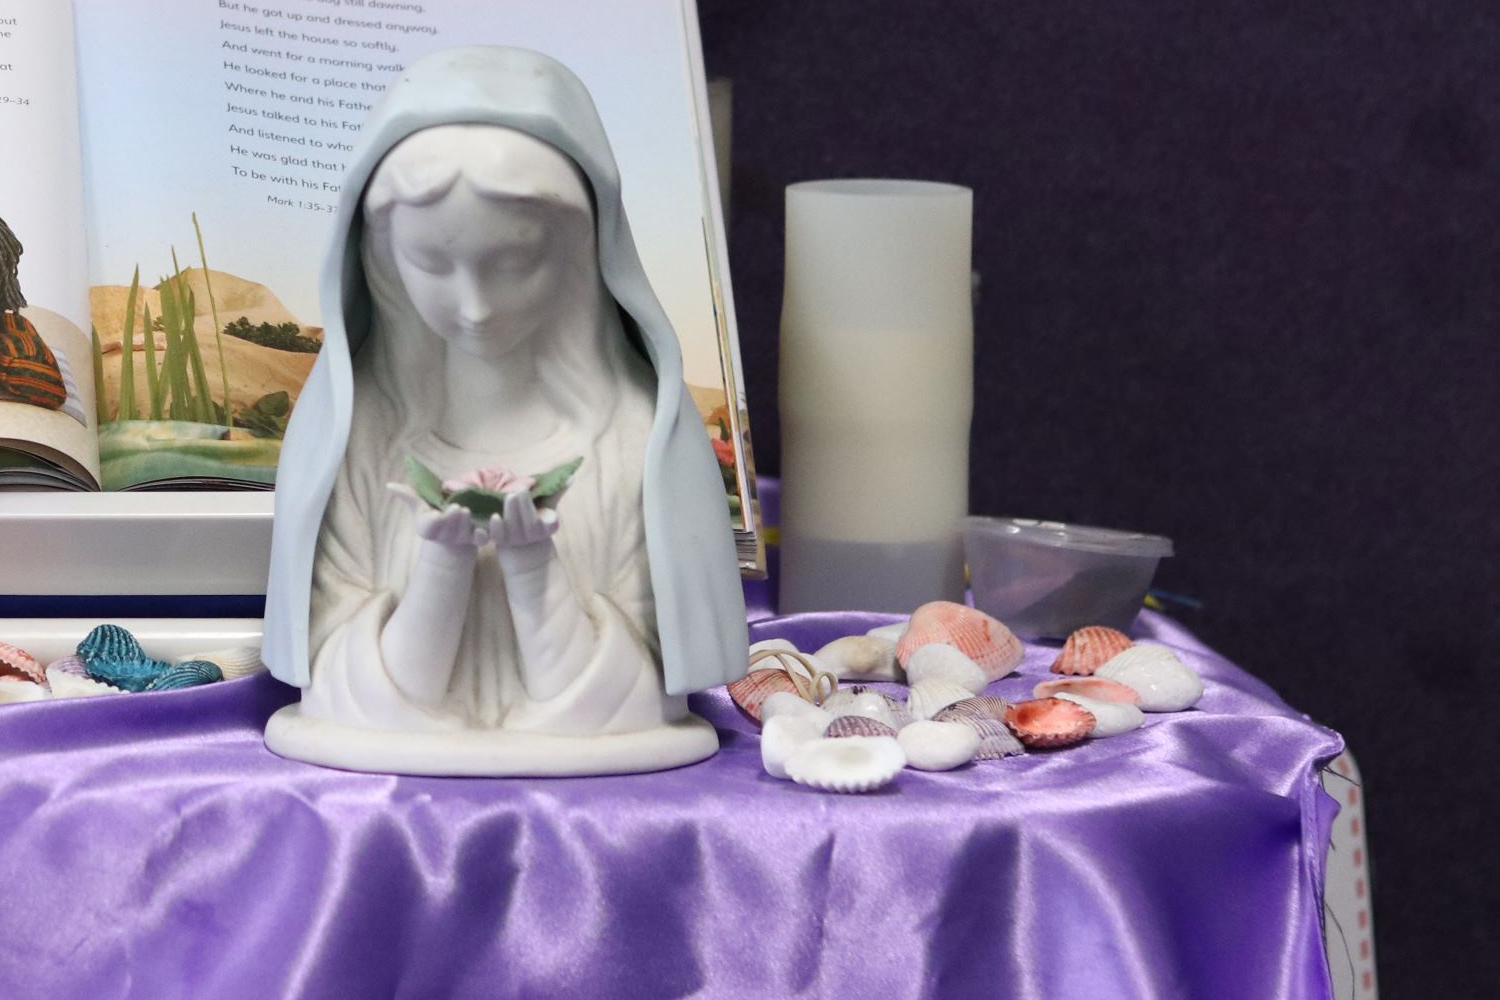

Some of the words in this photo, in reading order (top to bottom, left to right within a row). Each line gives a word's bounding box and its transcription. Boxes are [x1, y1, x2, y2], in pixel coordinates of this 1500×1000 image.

[221, 40, 248, 52] And
[250, 47, 282, 58] went
[285, 51, 303, 61] for
[318, 57, 373, 71] morning
[223, 60, 241, 71] He
[244, 64, 287, 79] looked
[290, 71, 308, 82] for
[323, 77, 357, 88] place
[360, 81, 386, 91] that
[224, 81, 267, 96] Where
[270, 89, 286, 100] he
[289, 95, 314, 104] and
[316, 96, 335, 107] his
[226, 102, 258, 116] Jesus
[261, 109, 300, 123] talked
[303, 116, 317, 126] to
[320, 118, 338, 128] his
[228, 123, 254, 136] And
[257, 128, 306, 145] listened
[308, 138, 323, 147] to
[229, 144, 248, 156] He
[251, 151, 277, 161] was
[280, 155, 308, 166] glad
[311, 159, 337, 171] that
[231, 165, 248, 176] To
[250, 169, 266, 180] be
[269, 175, 298, 186] with
[300, 178, 319, 189] his
[267, 194, 293, 206] Mark
